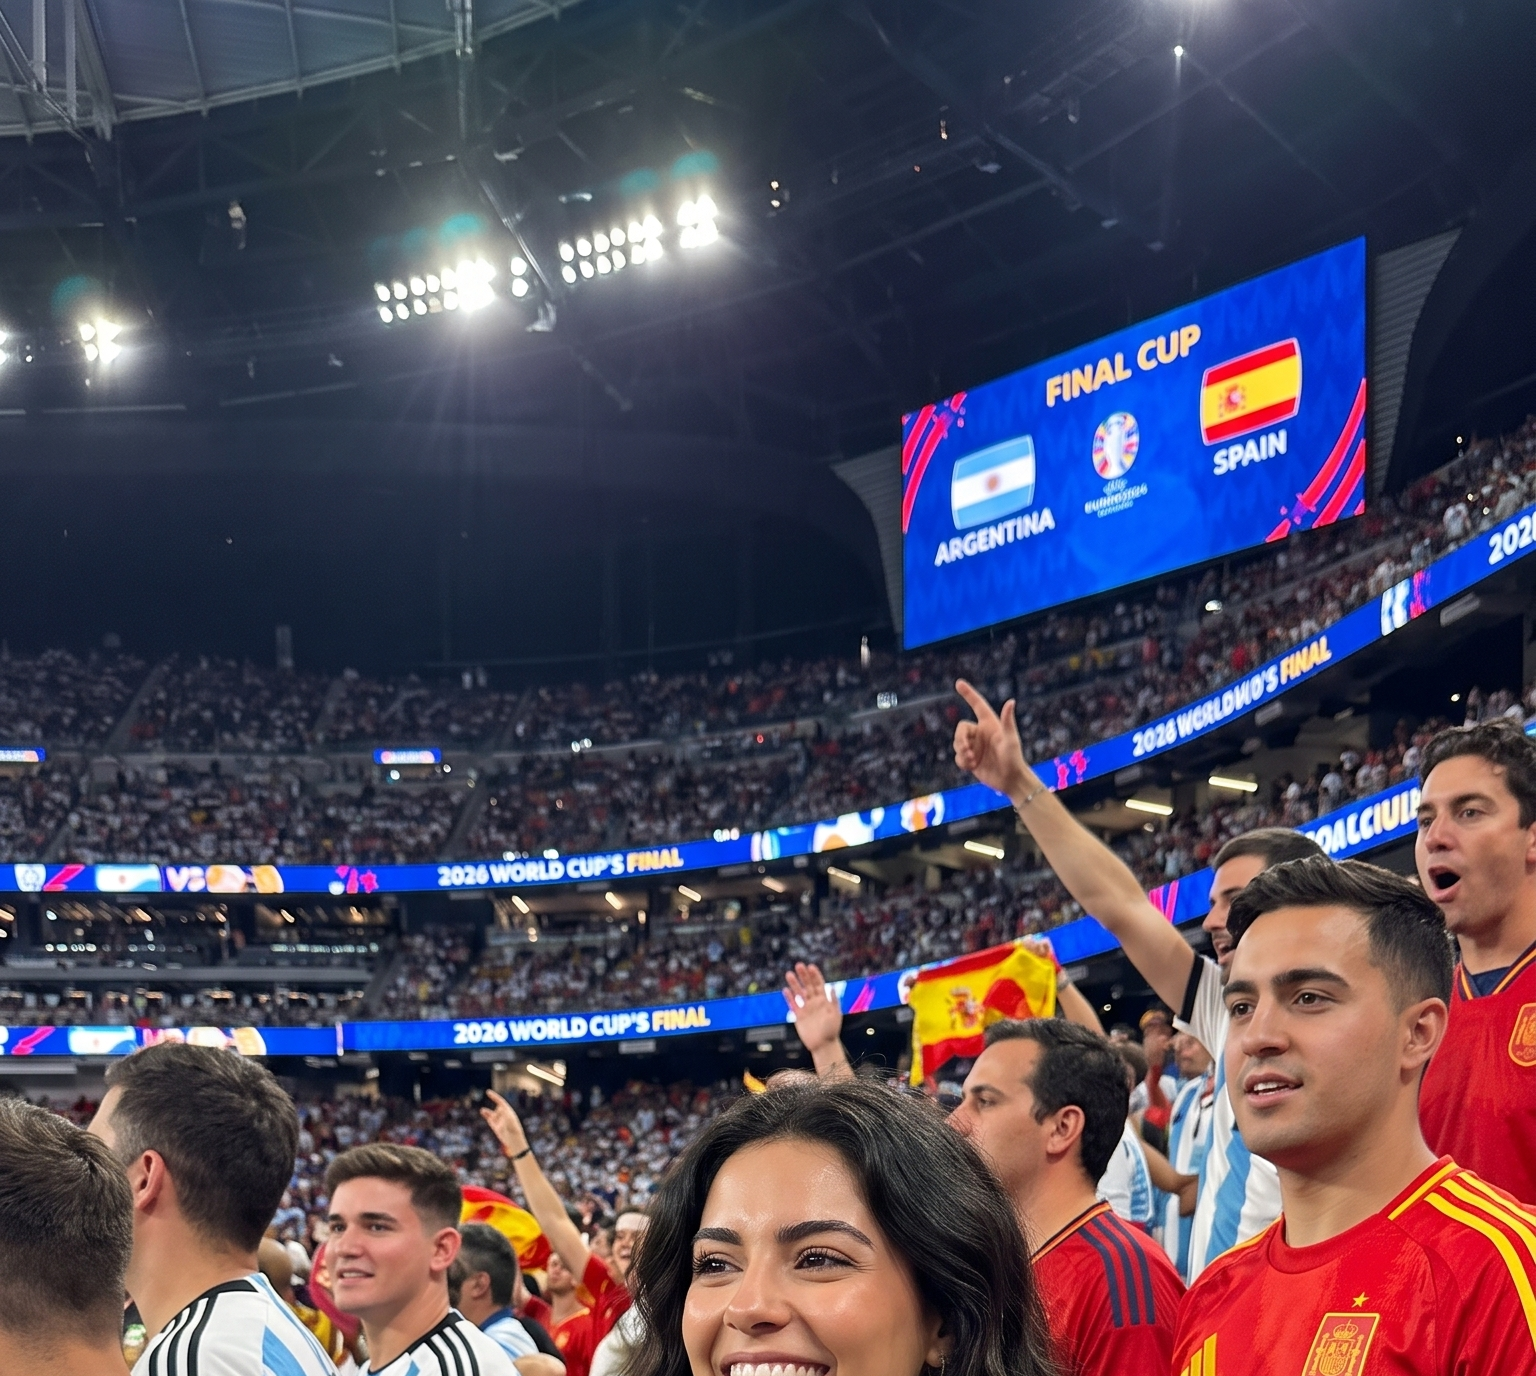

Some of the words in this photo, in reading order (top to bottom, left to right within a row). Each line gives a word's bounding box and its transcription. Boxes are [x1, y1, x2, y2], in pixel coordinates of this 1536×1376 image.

[1046, 351, 1132, 407] FINAL
[1137, 323, 1201, 371] CUP
[1212, 428, 1287, 475] SPAIN
[934, 507, 1055, 566] ARGENTINA
[1279, 635, 1332, 685] FINAL
[437, 864, 489, 887] 2026
[490, 858, 565, 884] WORLD
[566, 853, 624, 879] CUP'S
[626, 847, 684, 873] FINAL
[453, 1020, 508, 1044] 2026
[508, 1016, 587, 1042] WORLD
[589, 1011, 650, 1036] CUP'S
[652, 1006, 711, 1032] FINAL
